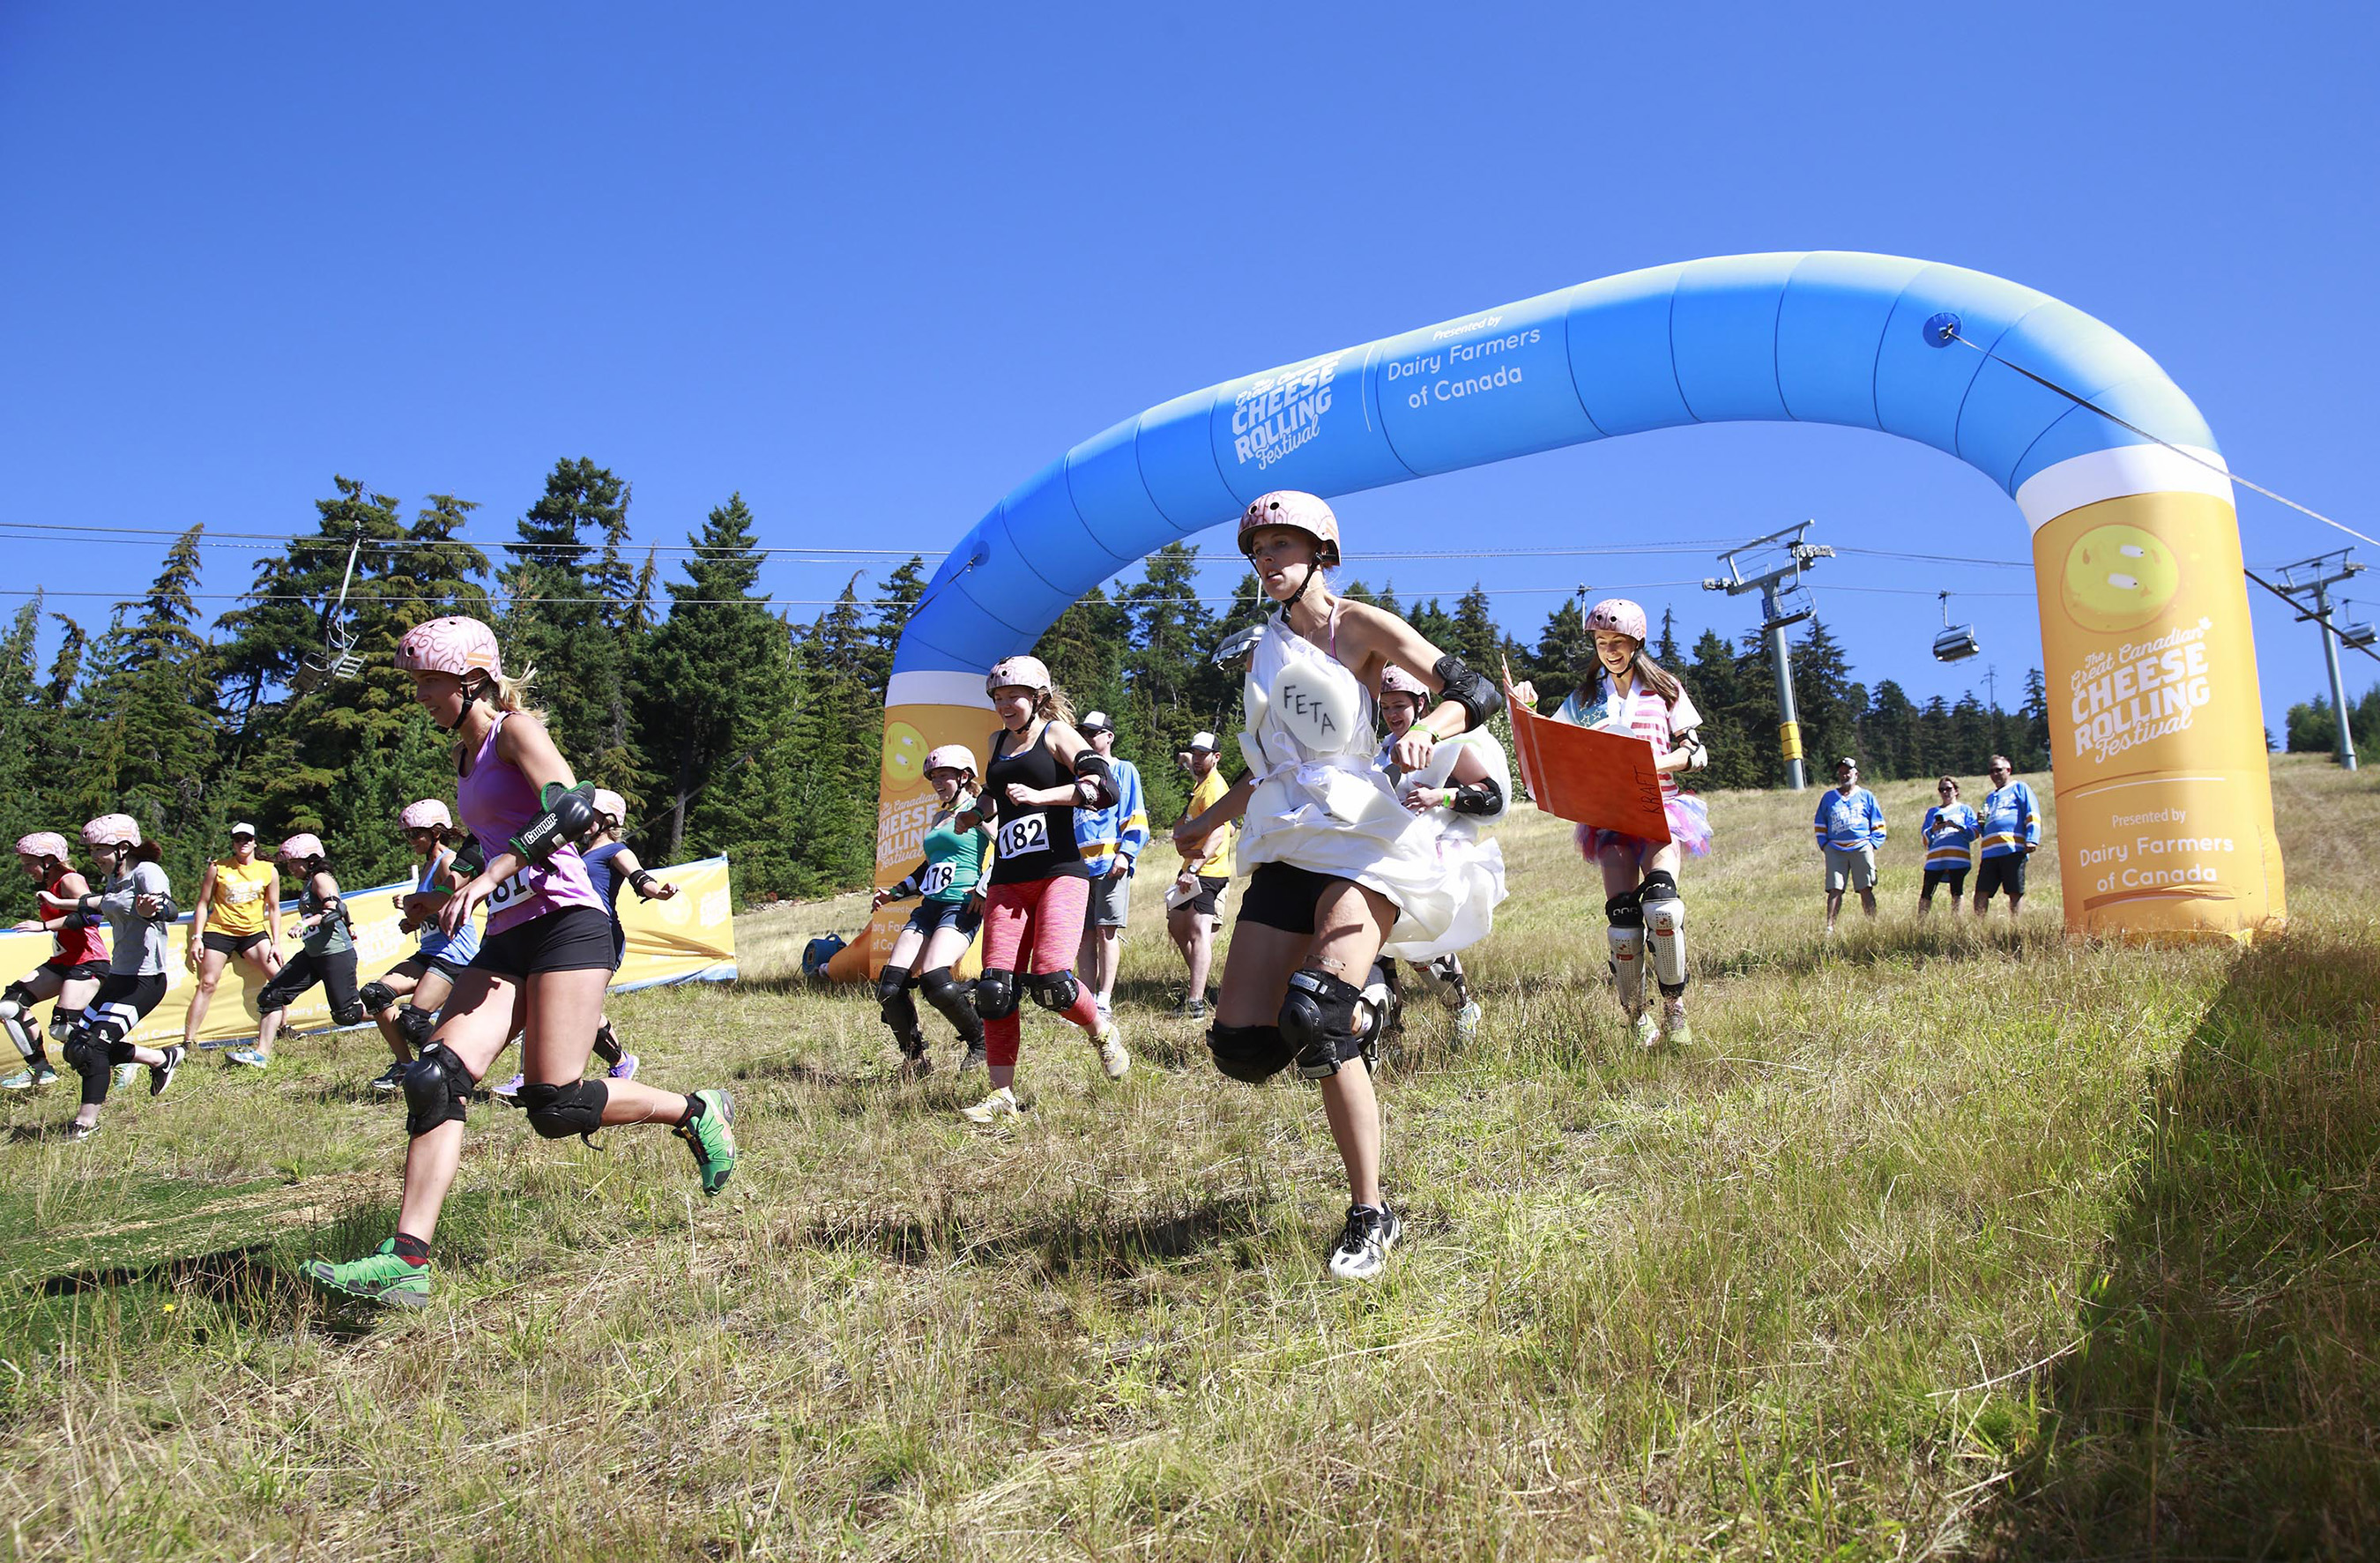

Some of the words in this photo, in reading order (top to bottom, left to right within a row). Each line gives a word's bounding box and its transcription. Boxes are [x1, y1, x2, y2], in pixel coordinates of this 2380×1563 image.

[1432, 318, 1487, 341] Presented
[1488, 316, 1503, 327] by
[1388, 354, 1441, 381] Dairy
[1449, 329, 1541, 365] Farmers
[1232, 360, 1339, 435] CHEESE
[1409, 385, 1428, 408] of
[1434, 365, 1522, 401] Canada
[1234, 386, 1333, 465] ROLLING
[1255, 413, 1320, 470] Festival
[2071, 652, 2115, 695] Great
[2118, 627, 2204, 663] Canadian
[2071, 641, 2209, 725] CHEESE
[2085, 651, 2105, 668] The
[1283, 684, 1336, 737] FETA
[2073, 676, 2210, 757] ROLLING
[2094, 705, 2193, 763] Festival
[1633, 764, 1662, 815] KRAFT
[524, 812, 559, 845] Cooper
[1002, 819, 1045, 857] 182
[2112, 808, 2168, 828] Presented
[2171, 808, 2186, 823] by
[2079, 843, 2128, 868] Dairy
[2137, 837, 2234, 856] Farmers
[2096, 872, 2115, 892] of
[2122, 863, 2218, 887] Canada
[923, 867, 953, 891] 178
